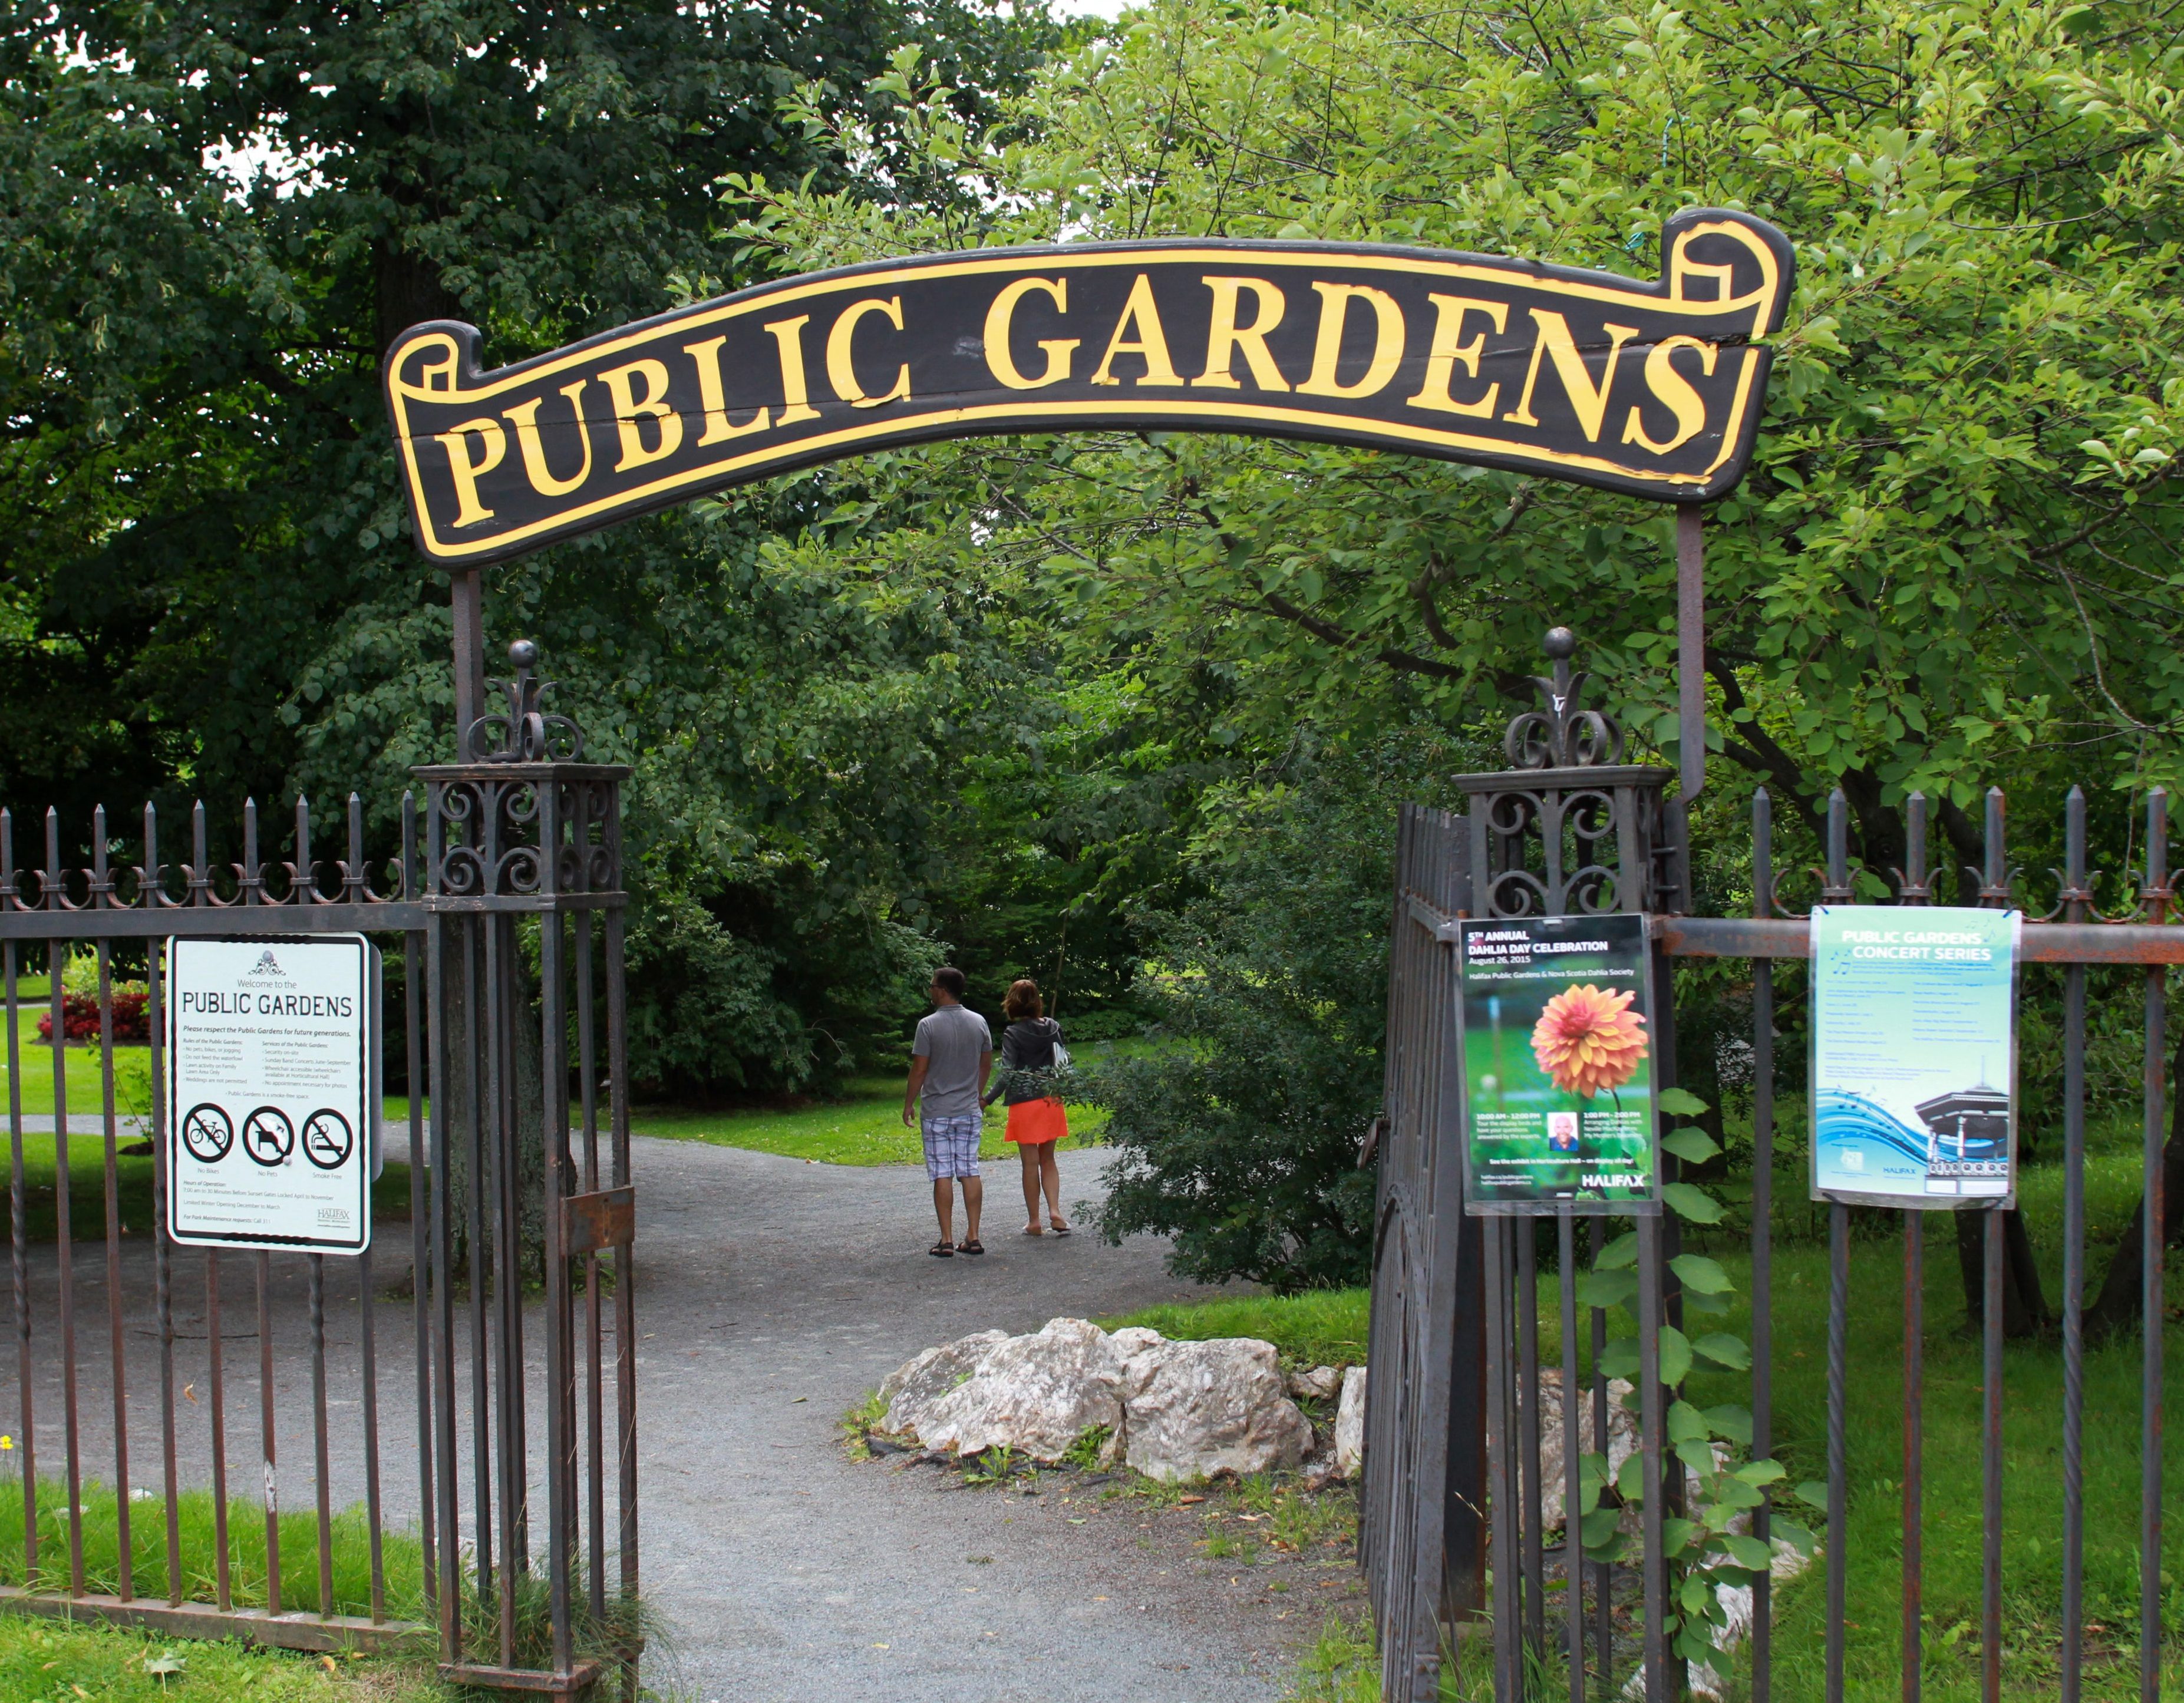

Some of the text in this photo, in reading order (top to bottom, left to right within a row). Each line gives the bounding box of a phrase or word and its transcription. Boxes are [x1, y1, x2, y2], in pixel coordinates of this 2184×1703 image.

[435, 275, 1717, 527] PUBLIC GARDENS
[1468, 931, 1529, 942] 5TH ANNUAL
[1842, 930, 1981, 945] PUBLIC GARDENS
[1469, 941, 1608, 955] DAHLIA DAY CELEBRATION
[1853, 946, 1991, 961] CONCERT SERIES
[1469, 957, 1495, 966] August
[1497, 956, 1509, 965] 26,
[237, 979, 273, 988] Welcome
[183, 992, 352, 1017] PUBLIC GARDENS
[1582, 1174, 1644, 1187] HALIFAX
[317, 1209, 349, 1219] HALIFAX
